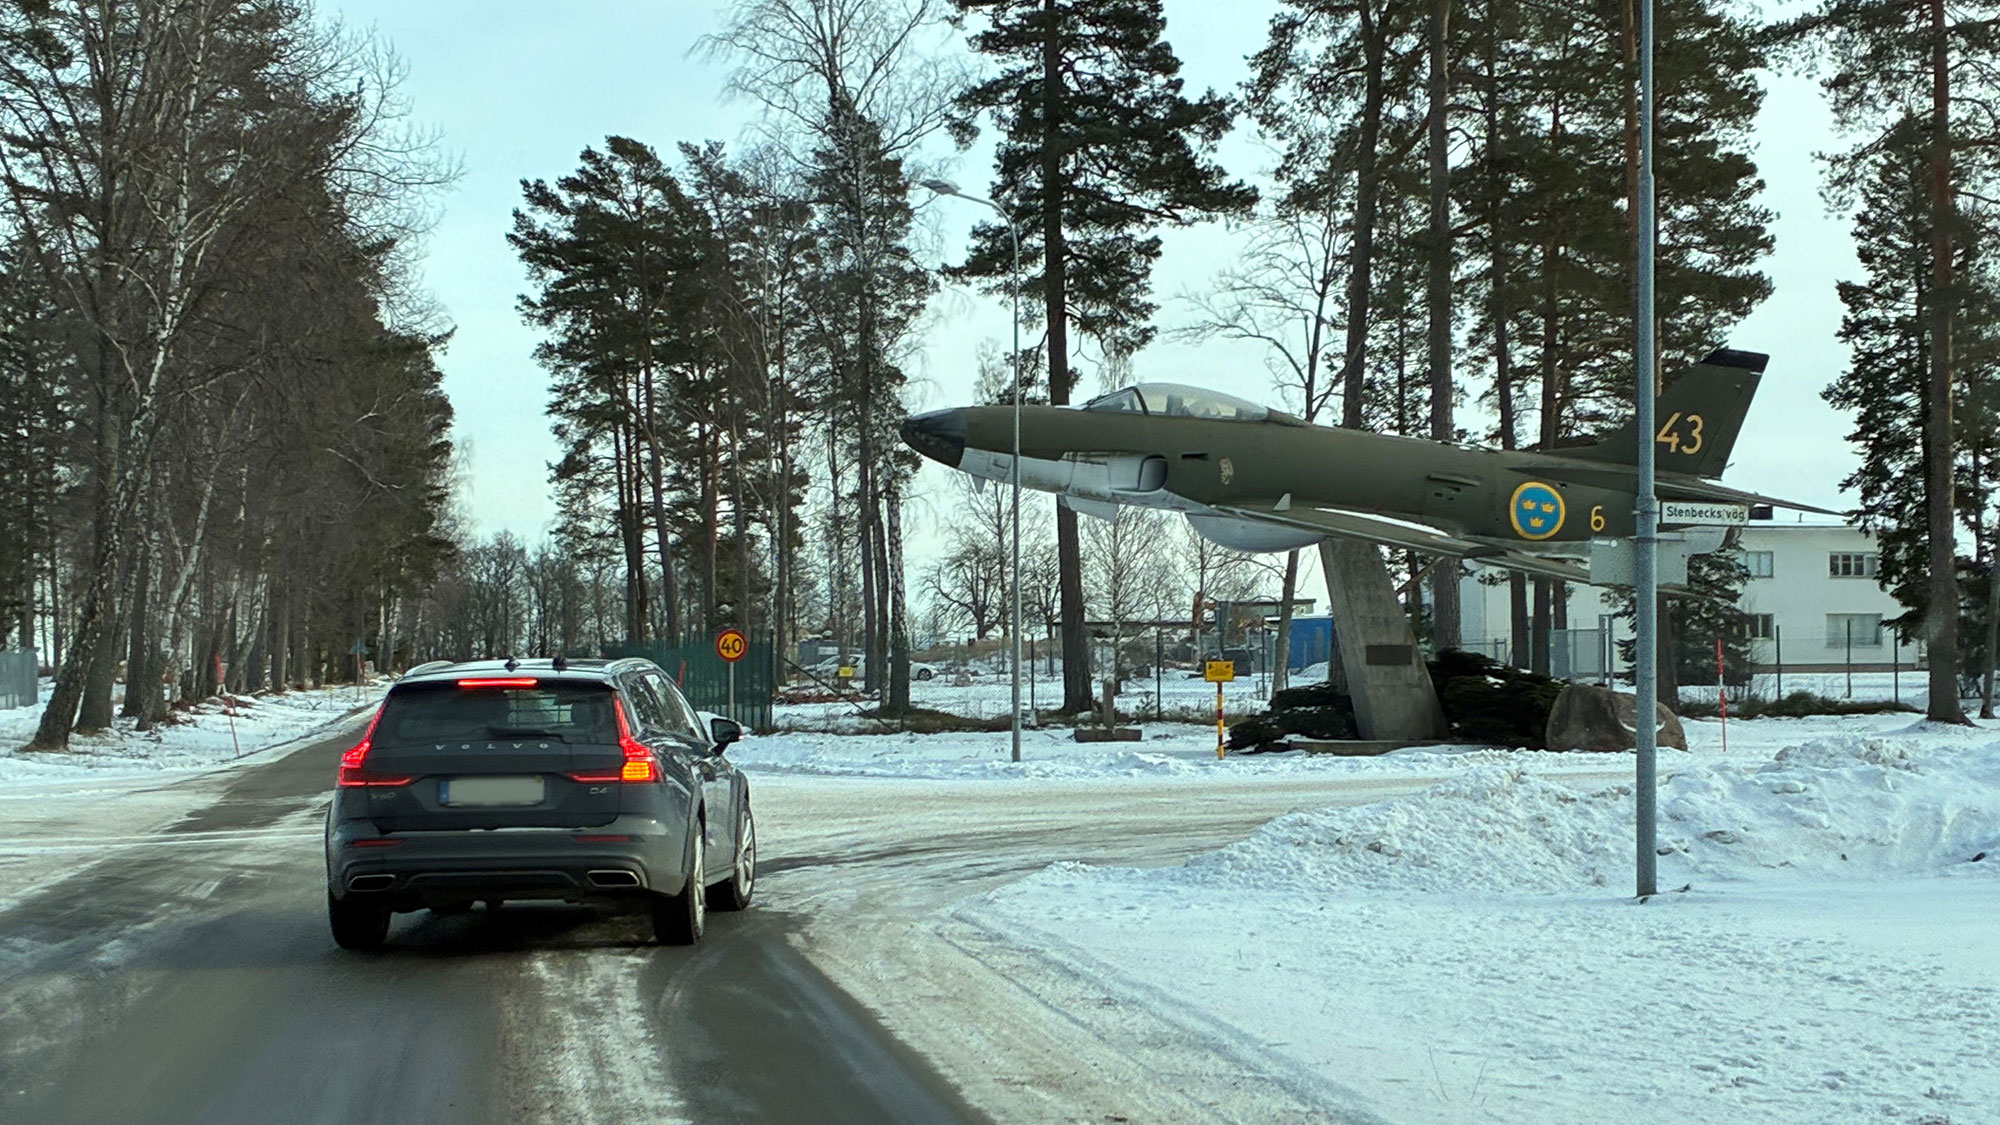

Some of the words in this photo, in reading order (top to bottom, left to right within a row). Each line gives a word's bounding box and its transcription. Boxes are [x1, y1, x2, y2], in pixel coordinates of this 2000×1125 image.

[1656, 412, 1704, 455] 43
[1590, 505, 1605, 532] 6
[1666, 506, 1722, 519] Stenbecks
[1725, 508, 1745, 523] väg
[721, 638, 742, 654] 40
[435, 743, 549, 751] VOLVO
[589, 787, 607, 795] D4
